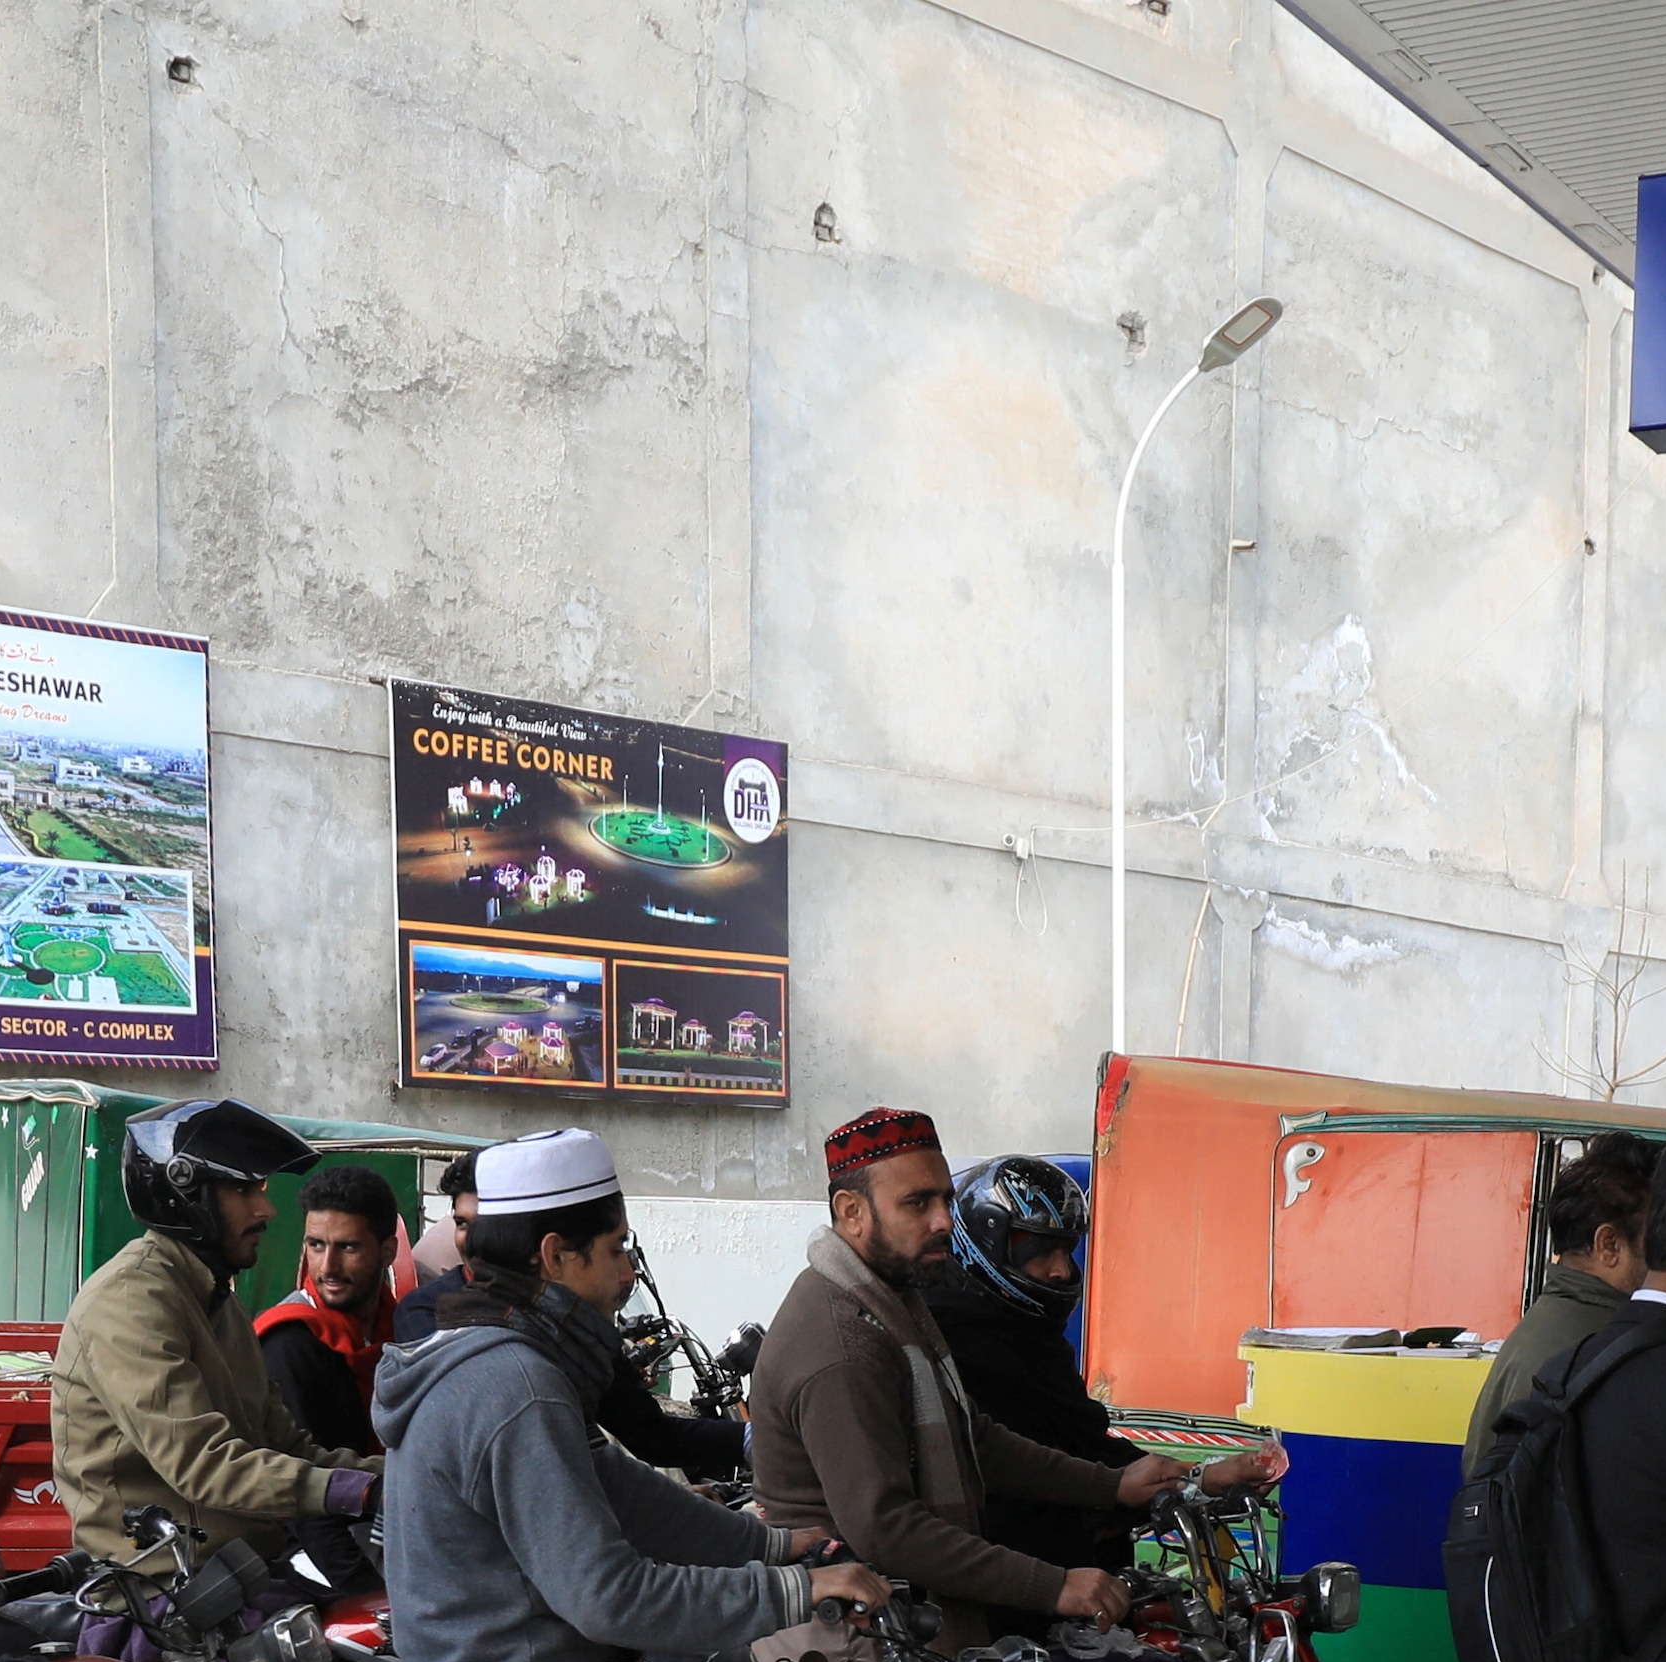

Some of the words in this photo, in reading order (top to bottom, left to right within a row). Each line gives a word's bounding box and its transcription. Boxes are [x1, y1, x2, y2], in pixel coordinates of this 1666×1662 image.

[21, 704, 69, 723] Dreams
[432, 702, 466, 726] Enjoy
[468, 710, 493, 726] with
[495, 717, 503, 728] a
[505, 715, 559, 738] Beautiful
[413, 727, 509, 766] COFFEE
[516, 742, 614, 781] CORNER
[734, 789, 771, 823] DHA
[0, 1016, 68, 1038] SECTOR
[83, 1021, 95, 1039] C
[99, 1021, 175, 1041] COMPLEX
